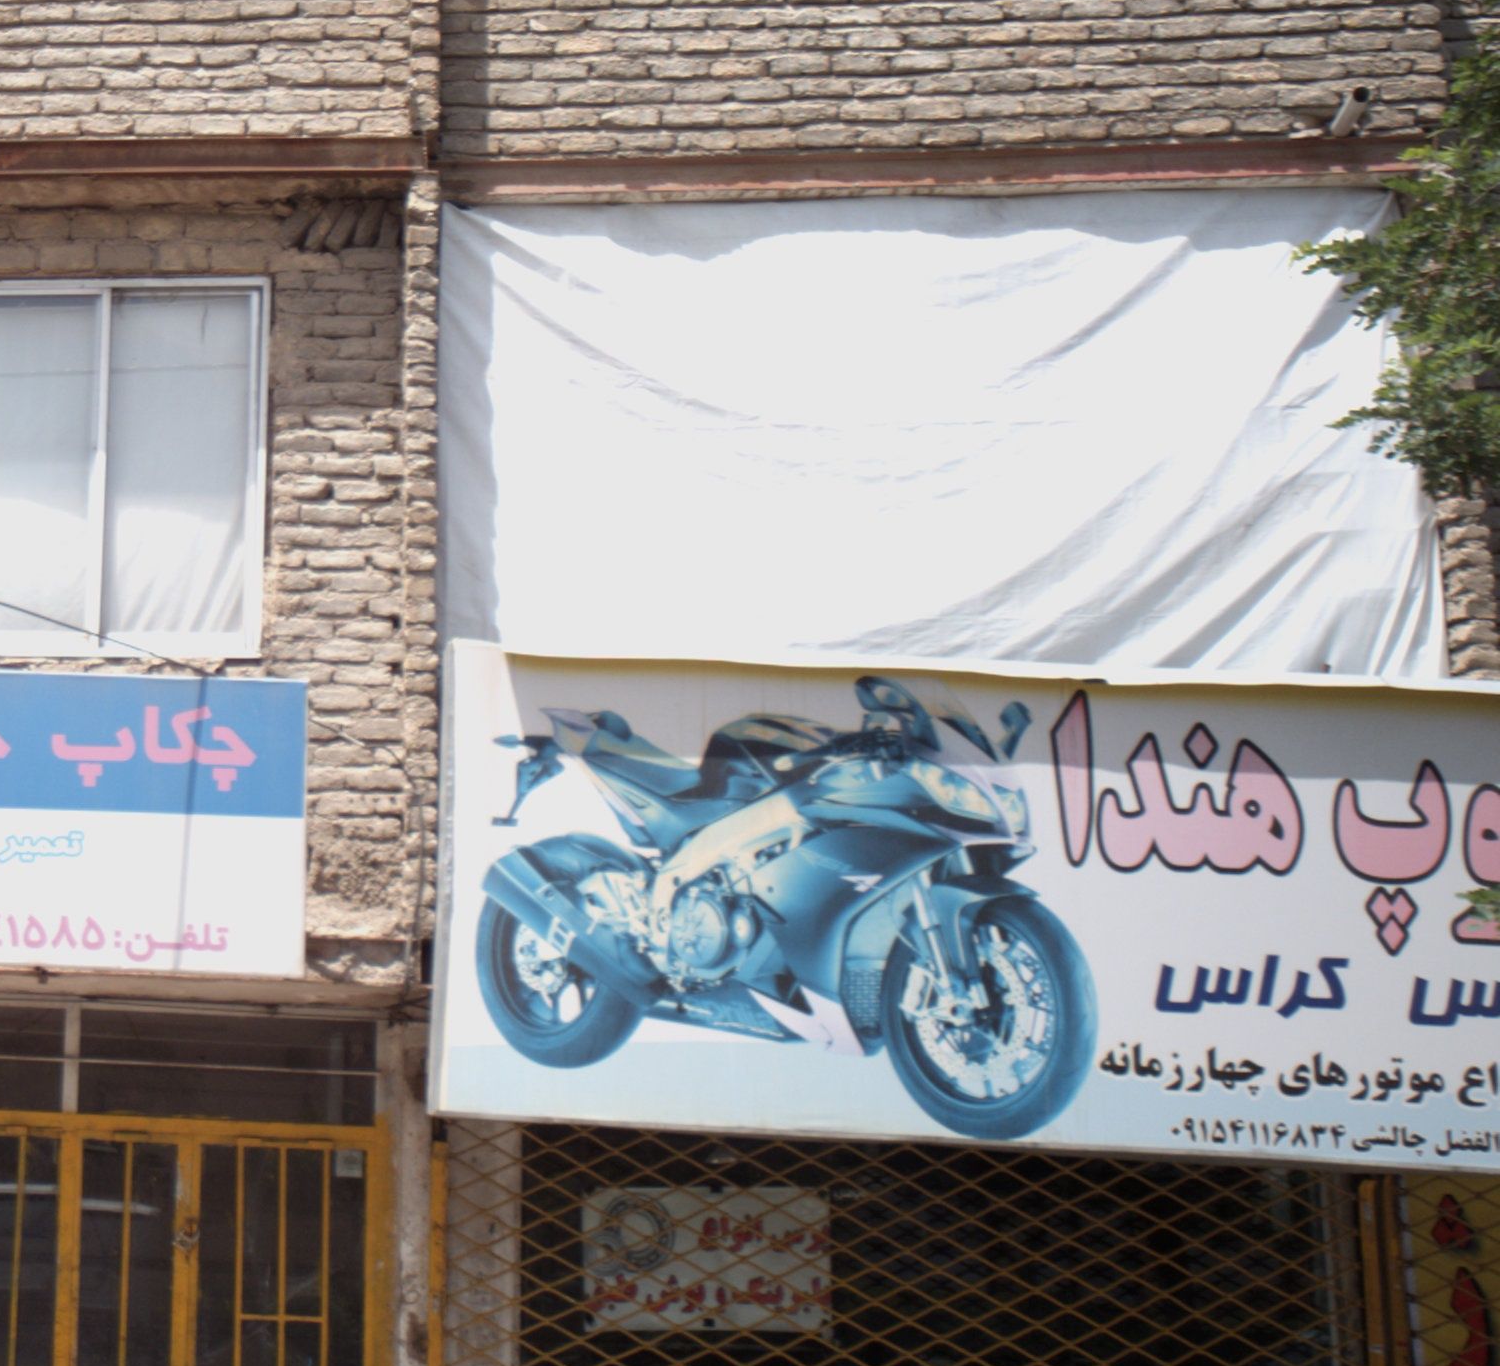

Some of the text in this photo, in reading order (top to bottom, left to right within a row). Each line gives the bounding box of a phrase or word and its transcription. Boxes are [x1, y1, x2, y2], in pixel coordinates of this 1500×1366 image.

[50, 705, 258, 792] چکاپ
[1050, 689, 1304, 876] هندا
[1155, 954, 1350, 1019] کراس
